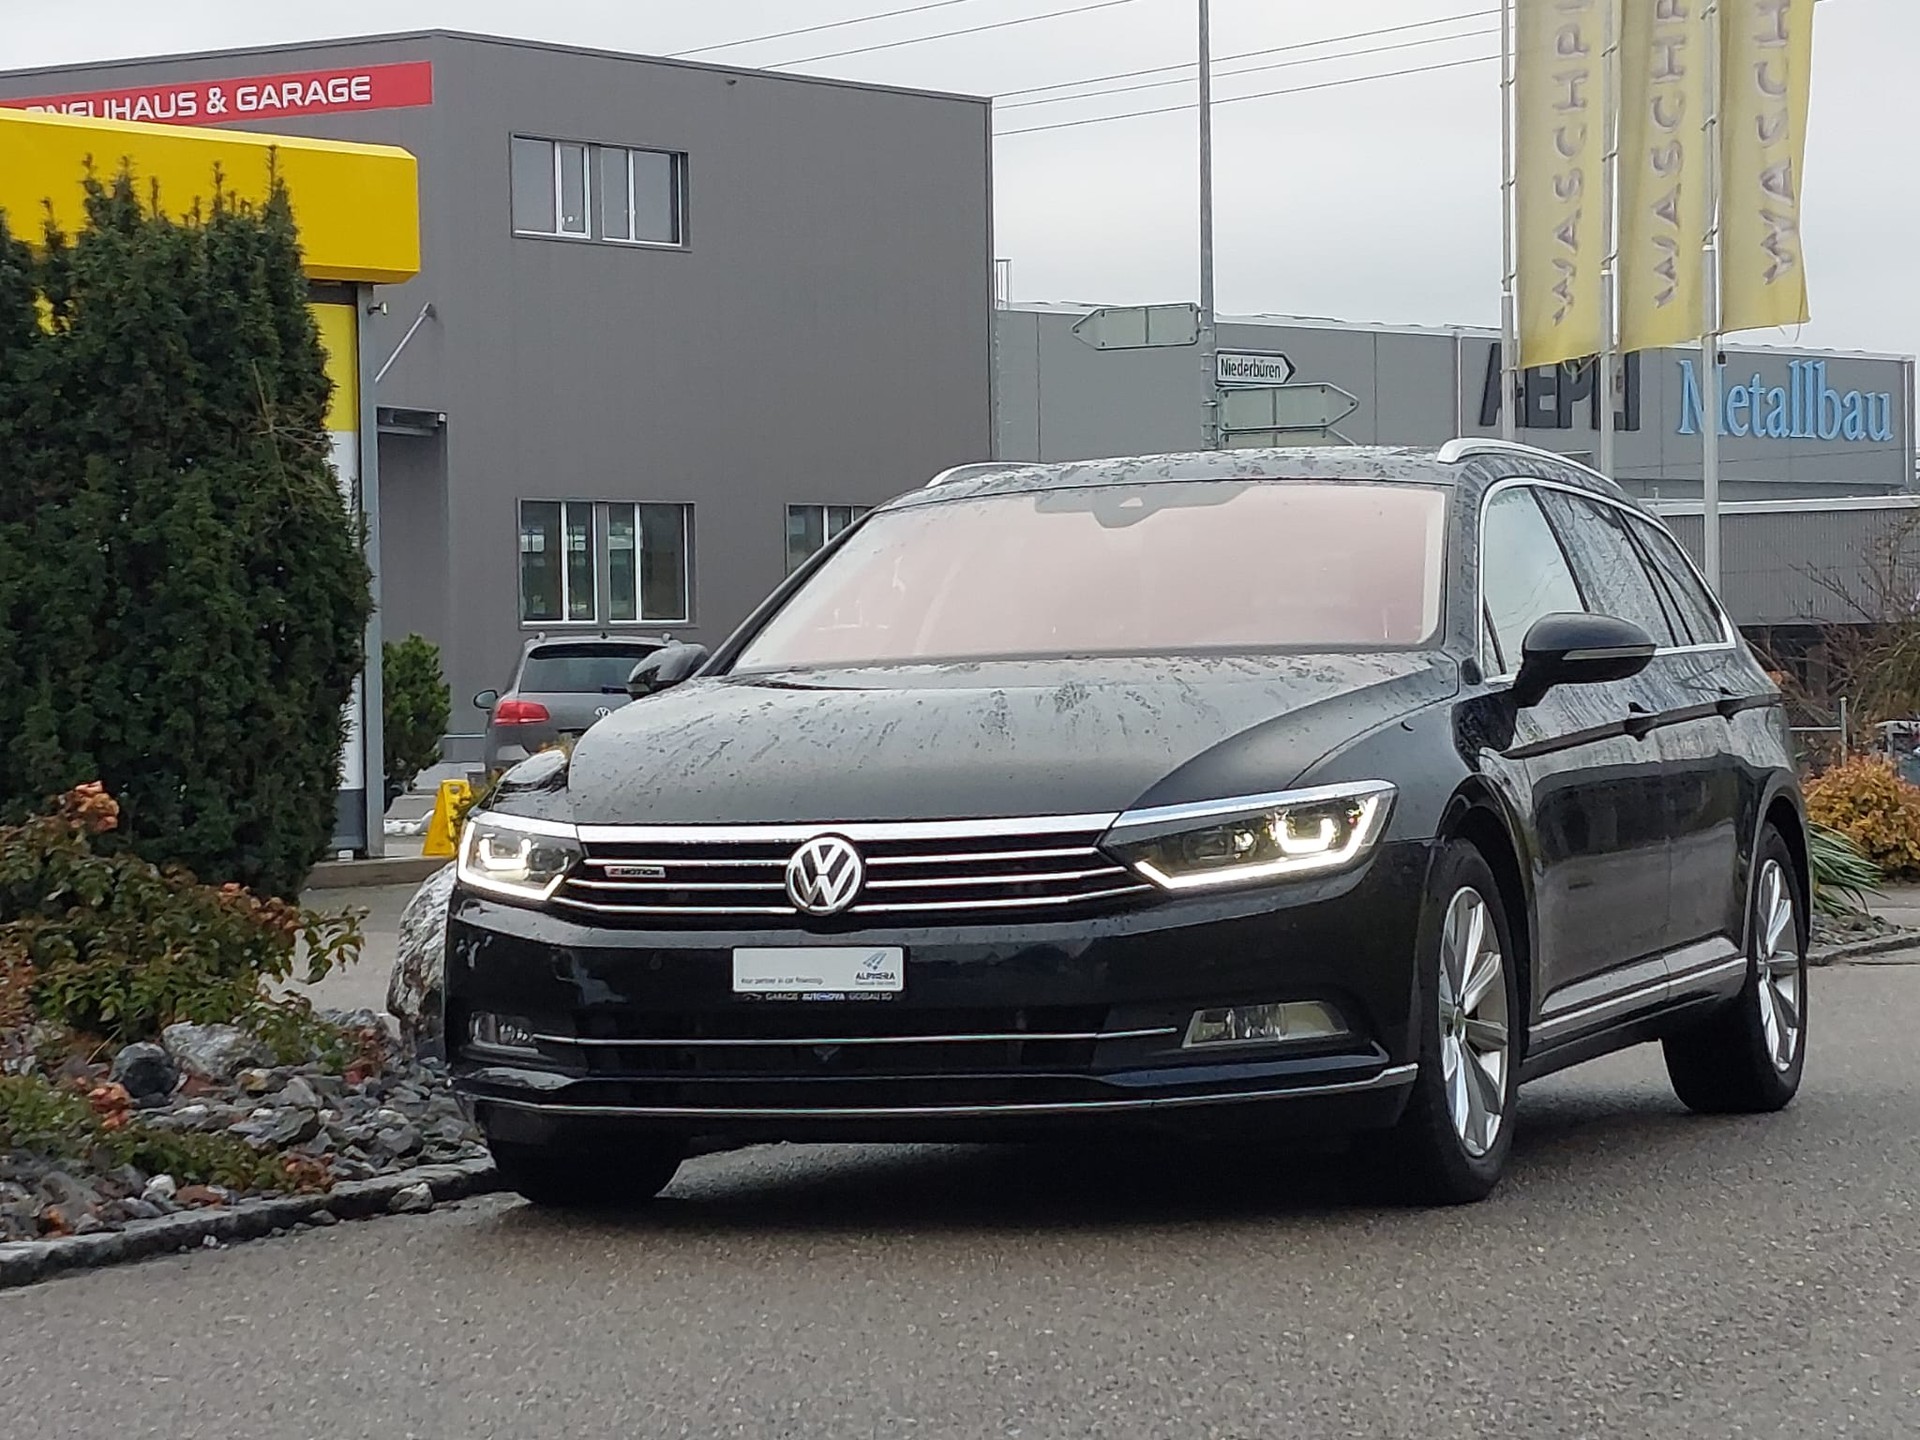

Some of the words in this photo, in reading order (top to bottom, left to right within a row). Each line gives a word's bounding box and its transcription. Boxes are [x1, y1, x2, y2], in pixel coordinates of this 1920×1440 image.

[206, 87, 227, 114] &
[236, 75, 371, 112] GARAGE
[1220, 358, 1281, 378] Niederbüren
[1678, 360, 1893, 440] Metallbau
